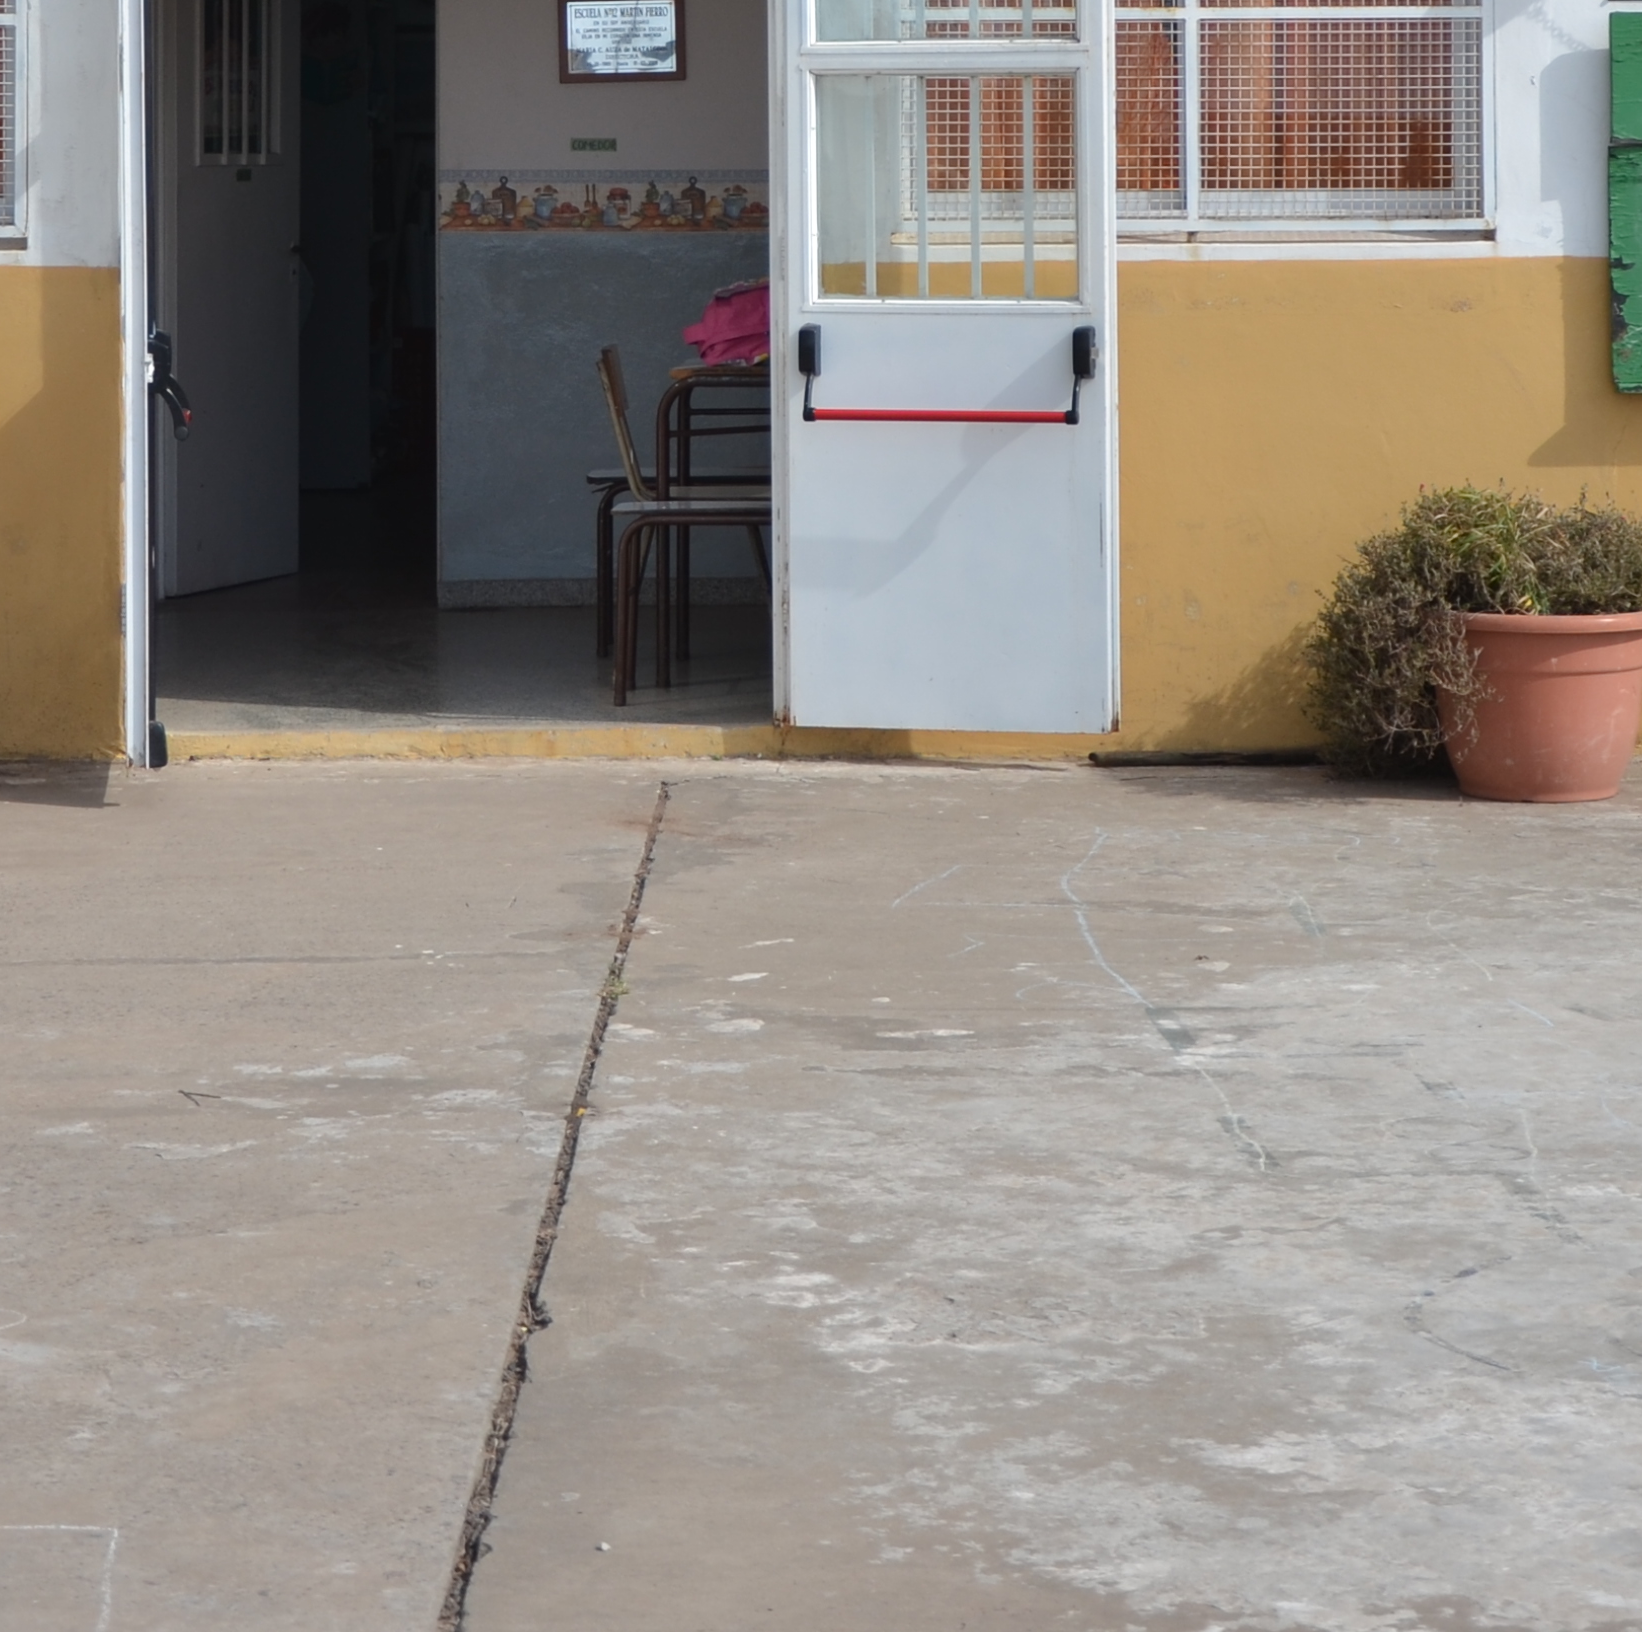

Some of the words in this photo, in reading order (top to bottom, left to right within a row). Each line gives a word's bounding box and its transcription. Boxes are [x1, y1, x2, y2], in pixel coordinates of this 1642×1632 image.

[574, 8, 602, 19] ESCUELA
[645, 6, 669, 17] FIERRO
[572, 139, 617, 151] COMEDOR
